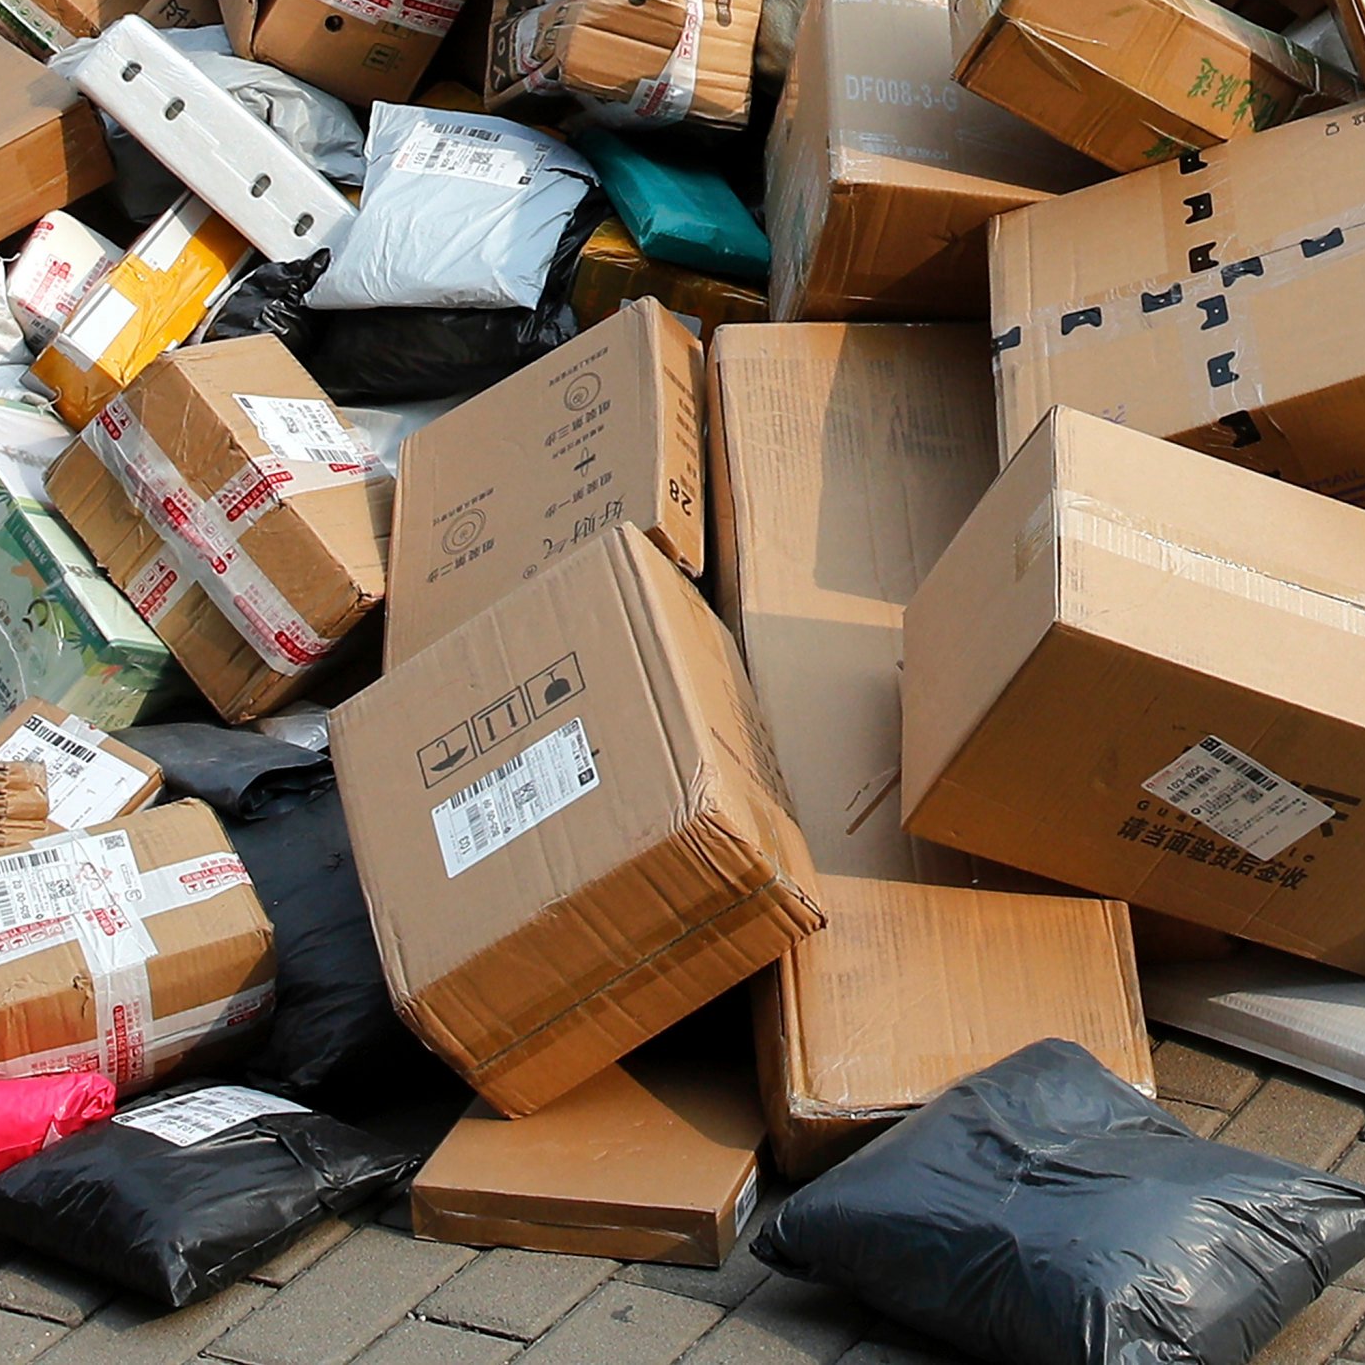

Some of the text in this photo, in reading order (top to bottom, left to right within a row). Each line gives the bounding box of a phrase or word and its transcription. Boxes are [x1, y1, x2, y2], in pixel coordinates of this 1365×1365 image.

[844, 74, 961, 112] DF008-3-G
[668, 478, 693, 517] 28
[458, 835, 471, 855] 103
[1117, 814, 1309, 890] 请当面验货后签收
